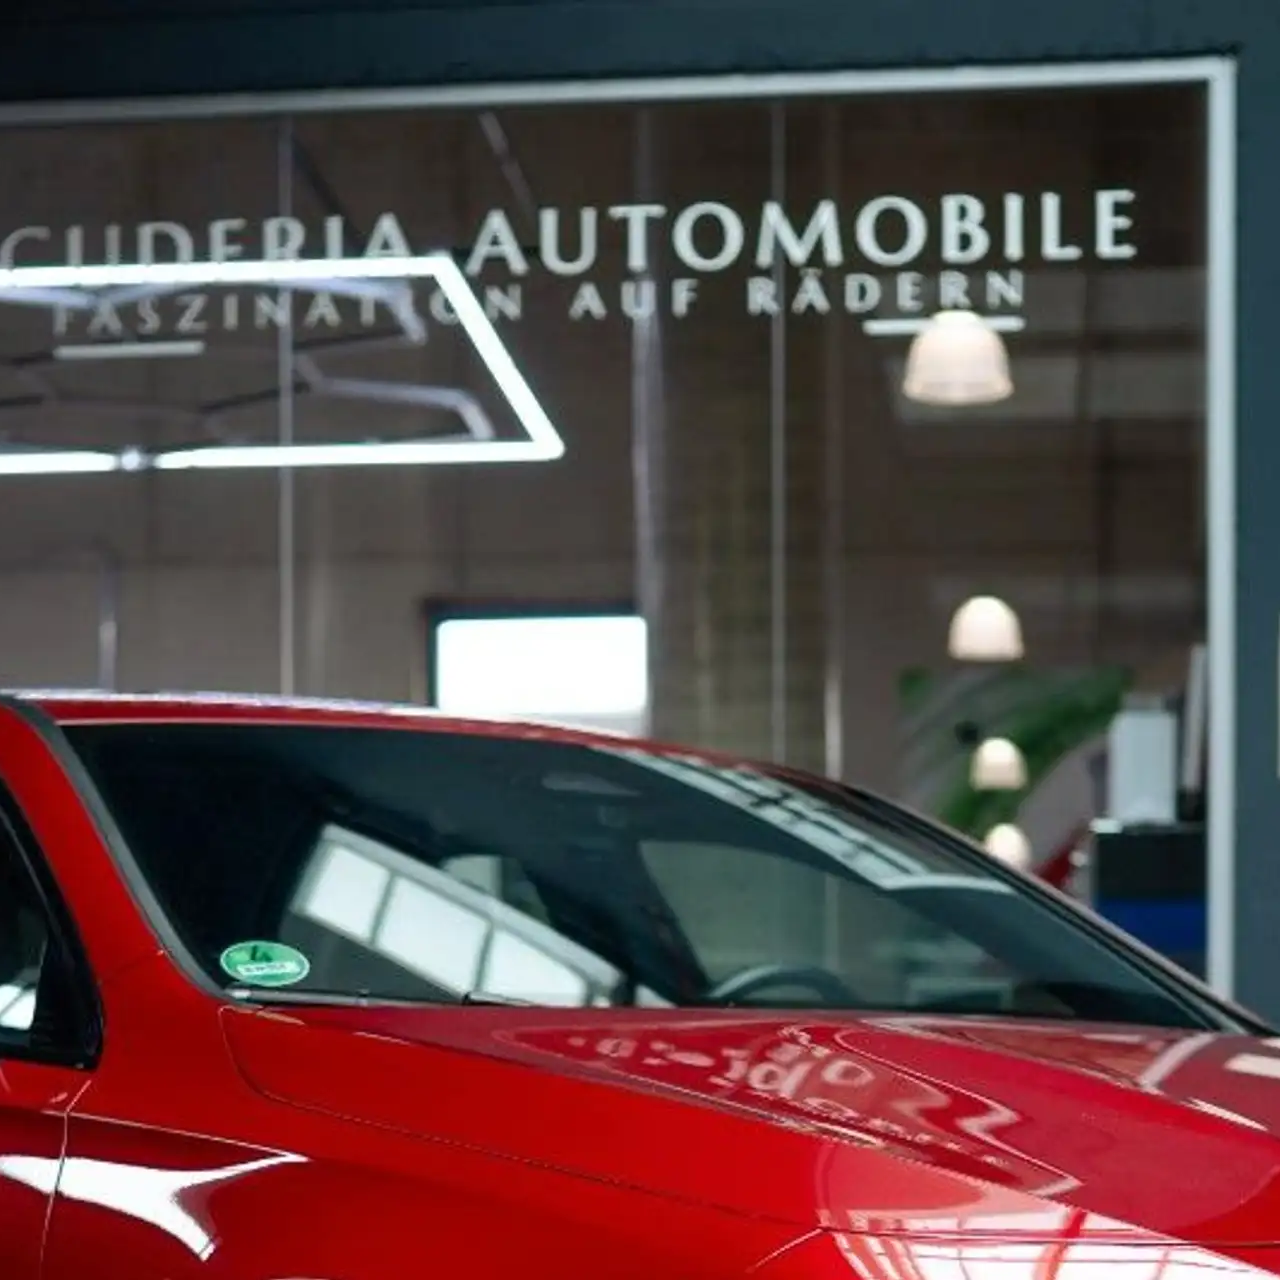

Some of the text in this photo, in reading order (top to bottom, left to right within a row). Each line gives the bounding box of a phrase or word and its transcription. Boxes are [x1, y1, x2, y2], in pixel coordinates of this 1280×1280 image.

[465, 188, 1138, 277] AUTOMOBILE
[52, 267, 1025, 338] FASZINATON AUF RÄDERN
